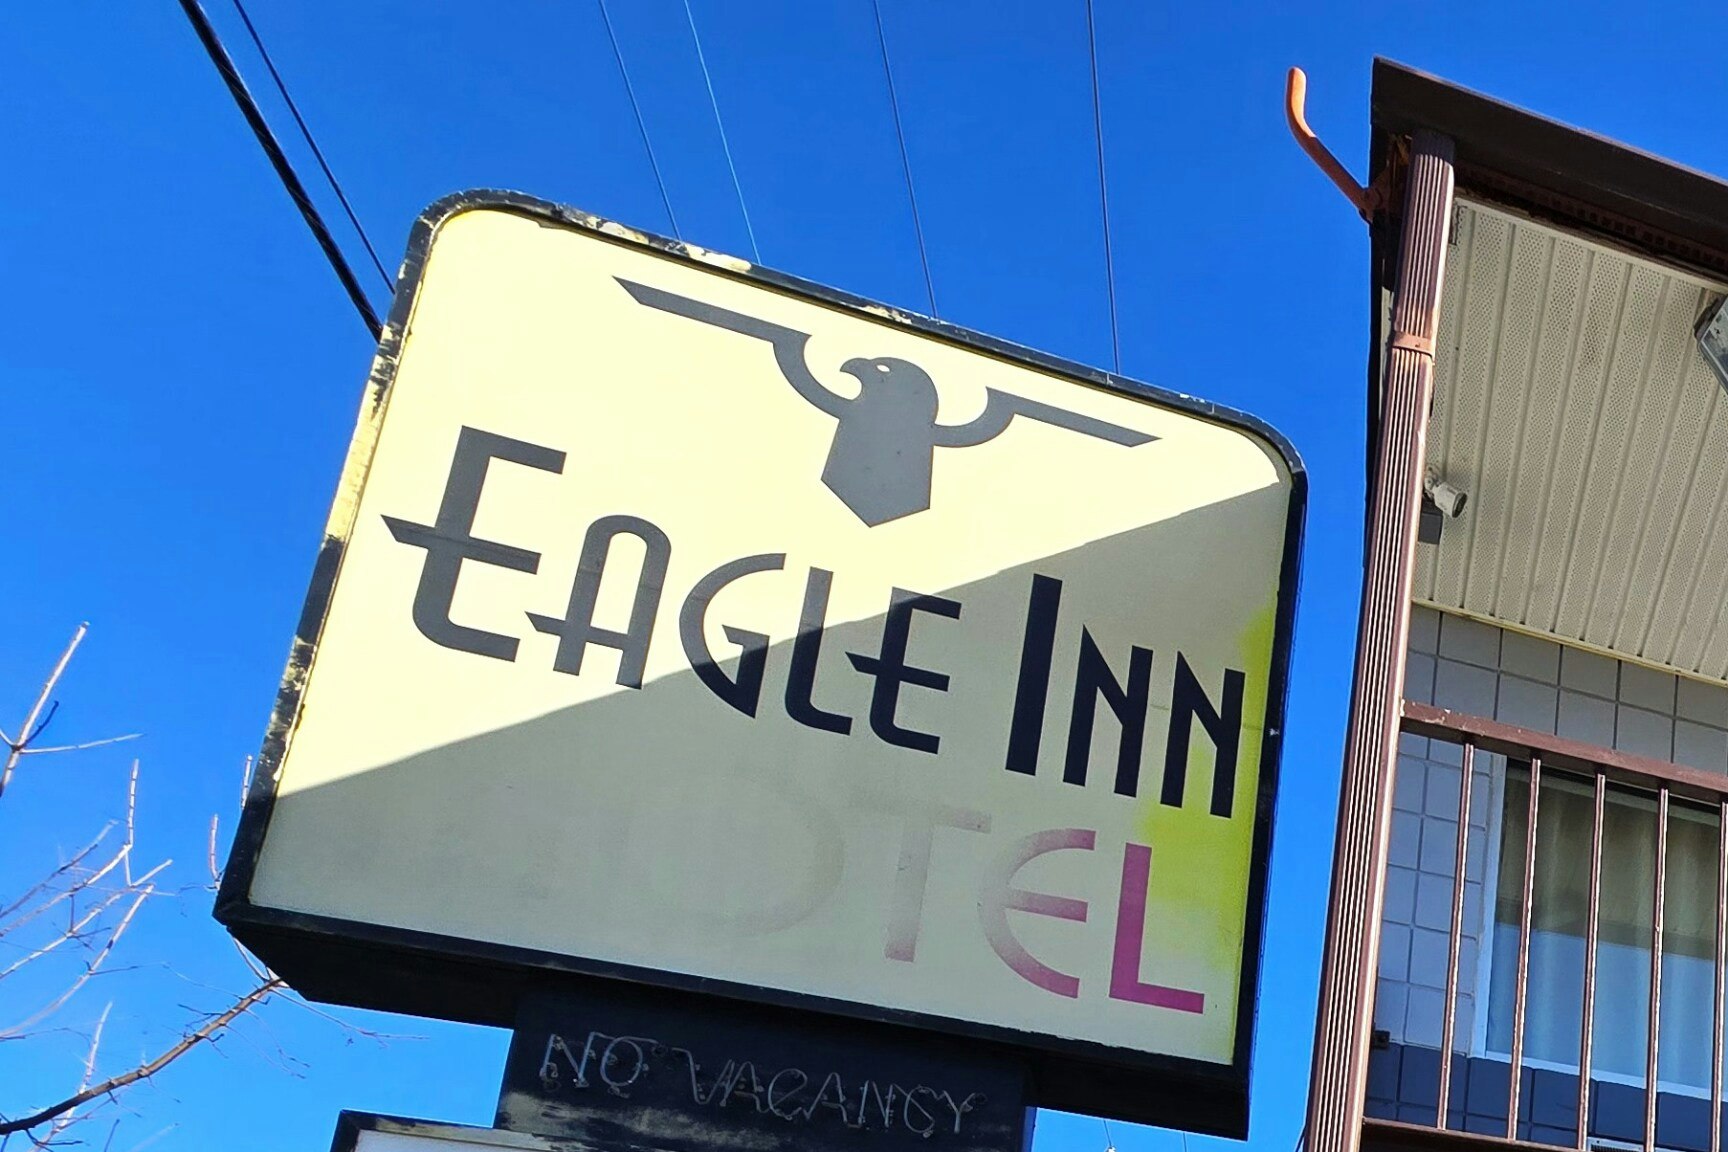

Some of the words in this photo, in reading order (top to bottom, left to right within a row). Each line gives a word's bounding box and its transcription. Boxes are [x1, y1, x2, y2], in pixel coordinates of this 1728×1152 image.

[381, 426, 960, 754] EAGLE
[1005, 573, 1246, 818] INN
[539, 1031, 644, 1090] NO
[690, 1048, 980, 1134] VACANCY
